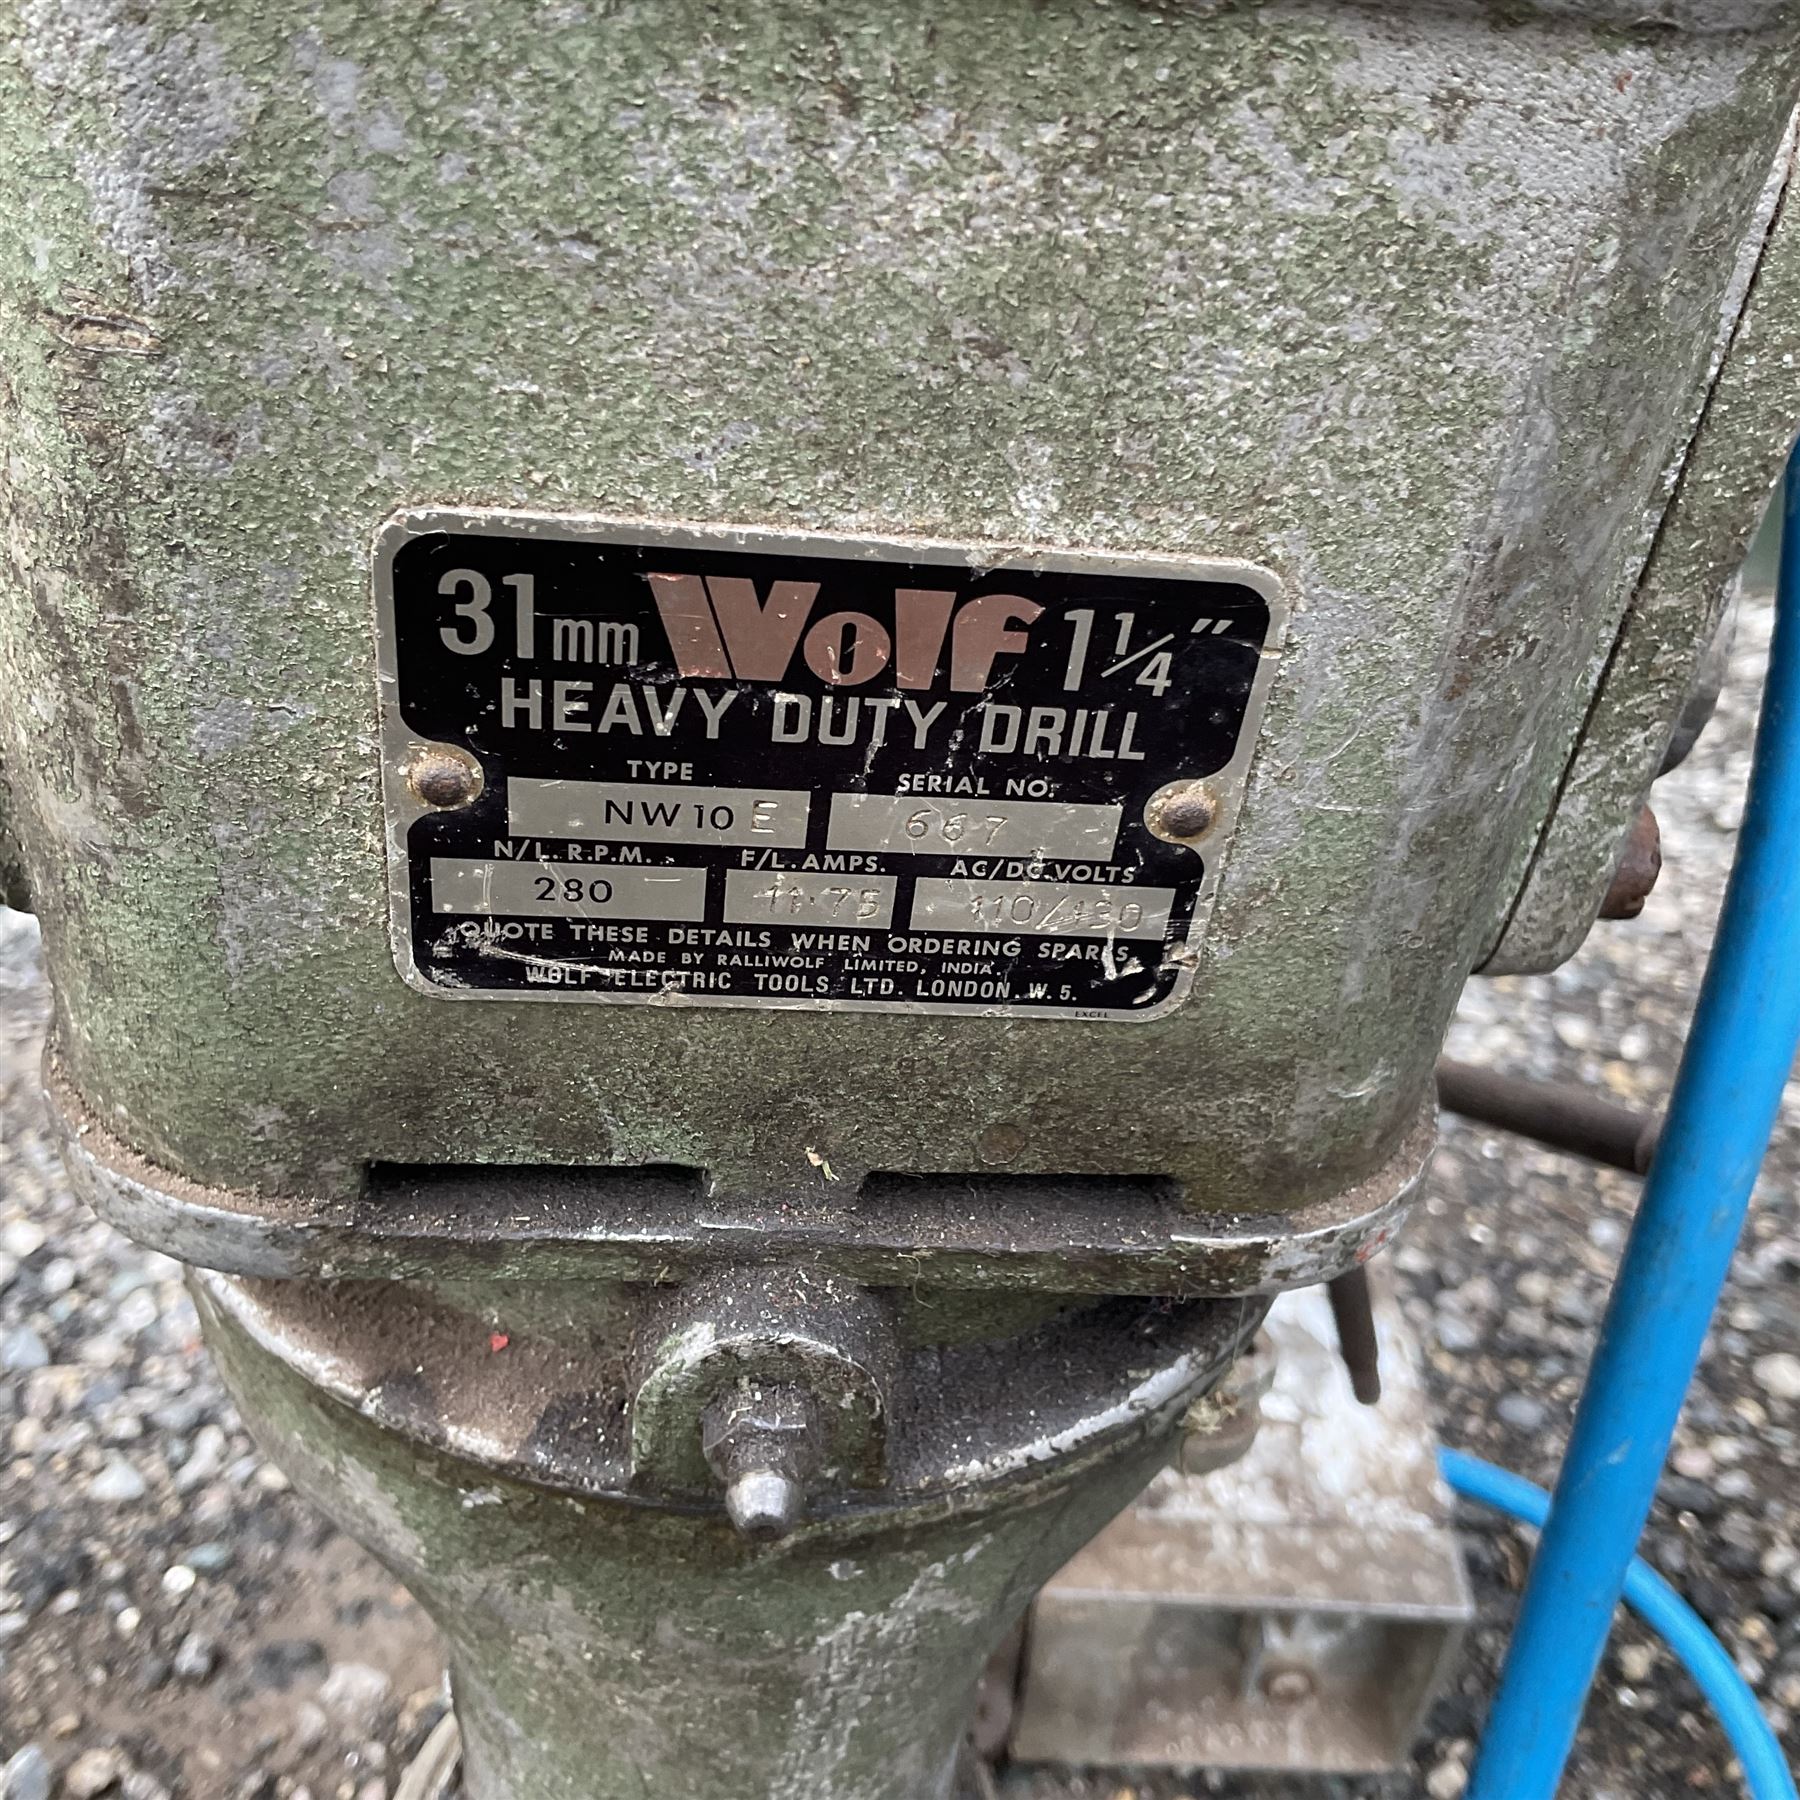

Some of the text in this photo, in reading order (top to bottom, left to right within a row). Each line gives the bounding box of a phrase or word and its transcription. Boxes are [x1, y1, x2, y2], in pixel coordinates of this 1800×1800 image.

[437, 568, 534, 659] 31
[553, 619, 639, 666] mm
[648, 572, 1045, 692] Wolf
[501, 678, 1146, 761] HEAVY DUTY DRILL
[627, 760, 693, 781] TYPE
[898, 773, 990, 795] SERIAL
[905, 809, 1008, 846] 667
[1055, 864, 1136, 884] VOLTS
[534, 876, 613, 904] 280
[460, 920, 1129, 962] QUOTE THESE DETAILS WHEN ORDERING SPARS
[608, 950, 666, 964] MADE
[681, 952, 704, 965] BY
[717, 954, 825, 969] RALLIWOLF
[525, 965, 592, 985] WOLF
[614, 970, 732, 989] ELECTRIC
[754, 973, 829, 993] TOOLS
[850, 978, 904, 996] LTD.
